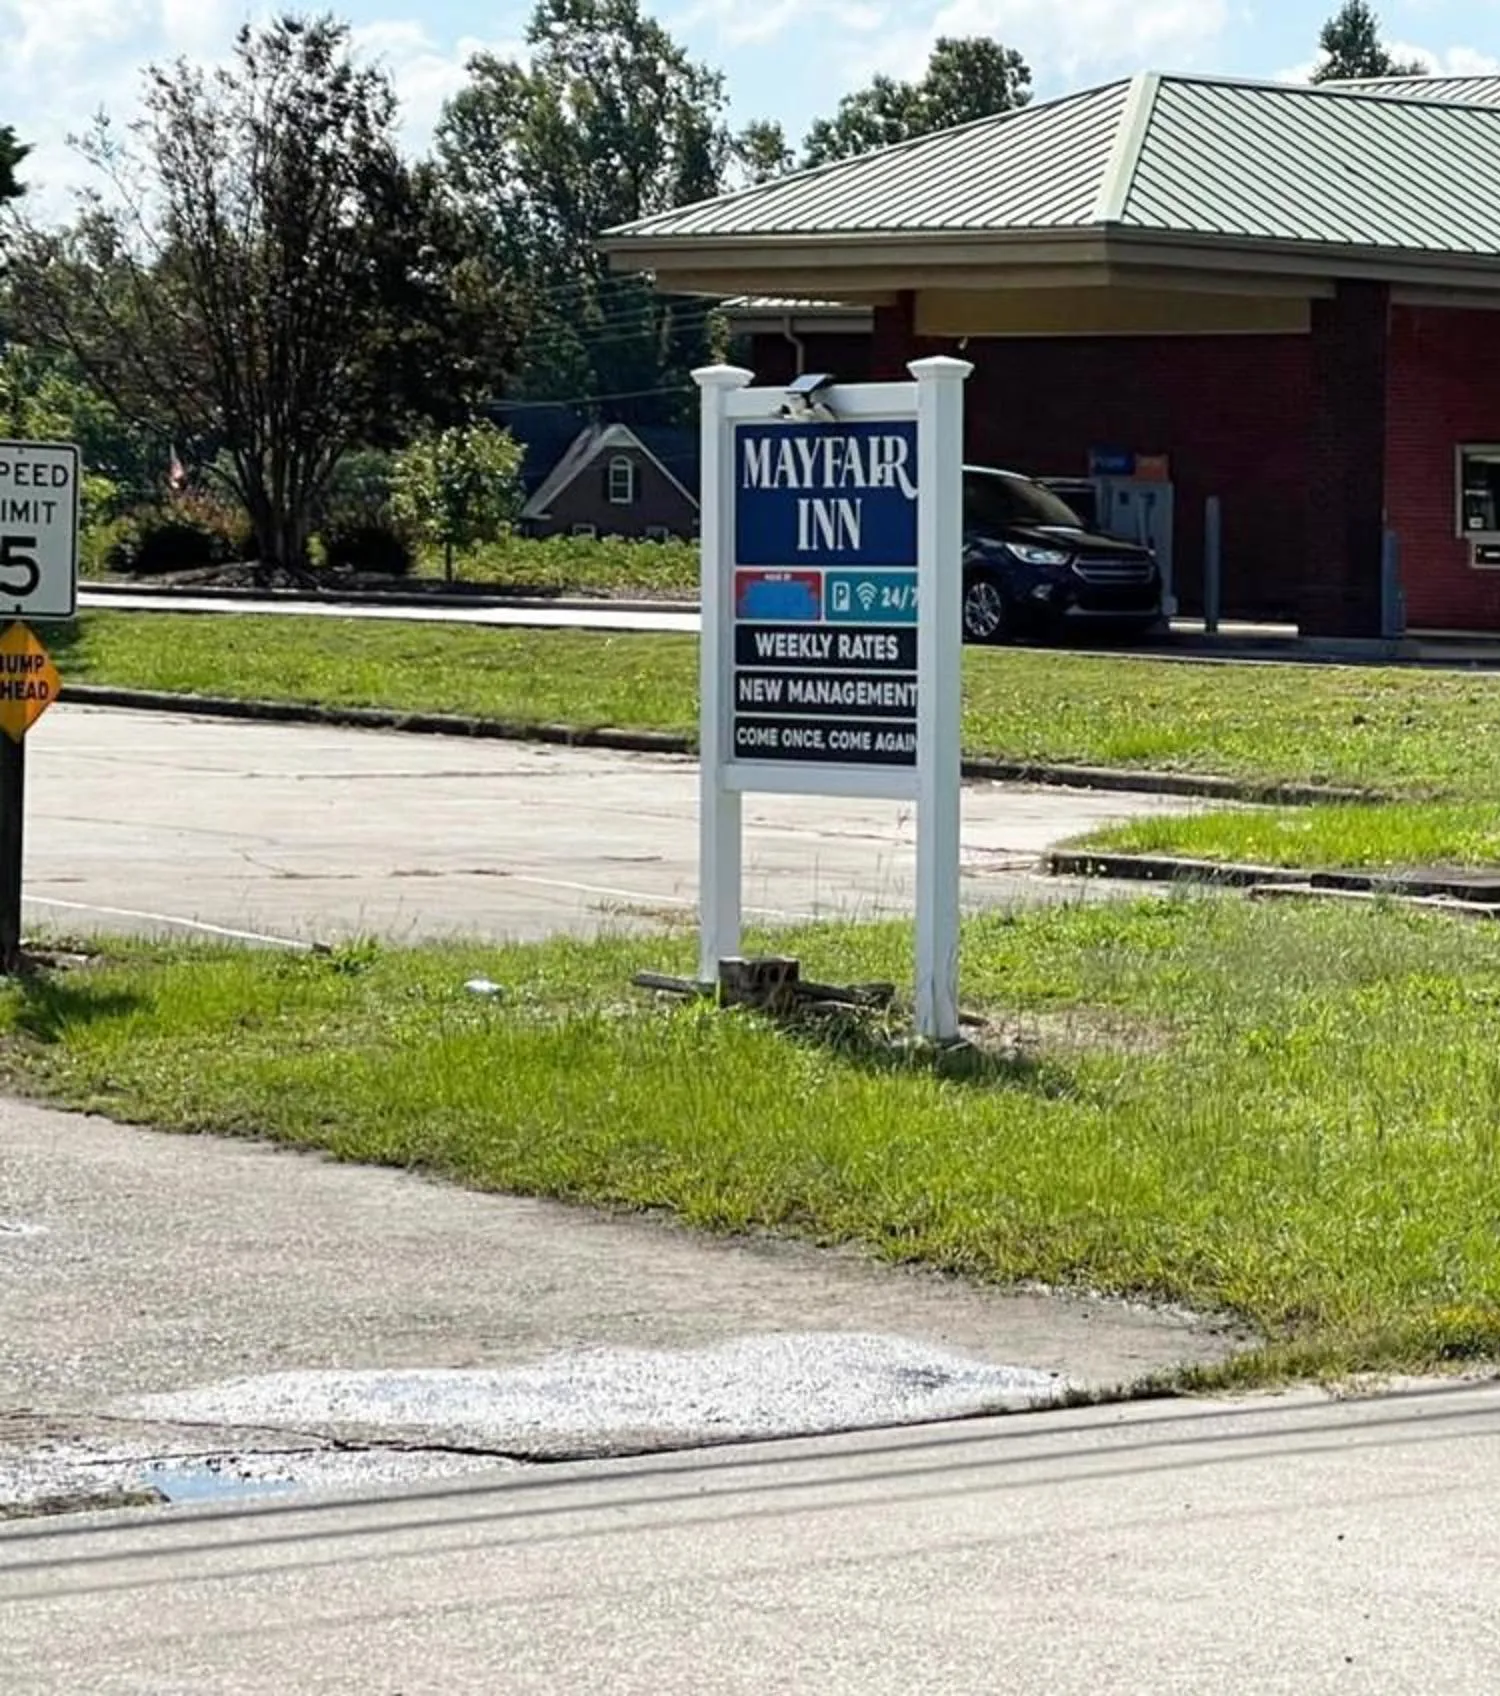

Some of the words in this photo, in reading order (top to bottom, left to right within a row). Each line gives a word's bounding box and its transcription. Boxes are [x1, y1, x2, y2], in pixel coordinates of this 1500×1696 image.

[0, 461, 69, 488] PEED
[743, 435, 918, 498] MAYFAIR
[1, 498, 57, 524] IMIT
[797, 498, 862, 551] INN
[882, 585, 918, 610] 24/7
[755, 633, 832, 659] WEEKLY
[838, 635, 898, 661] RATES
[0, 680, 49, 701] HEAD
[739, 678, 783, 703] NEW
[788, 679, 917, 707] MANAGEMENT
[737, 727, 778, 747] COME
[782, 729, 826, 749] ONCE,
[828, 731, 871, 751] COME
